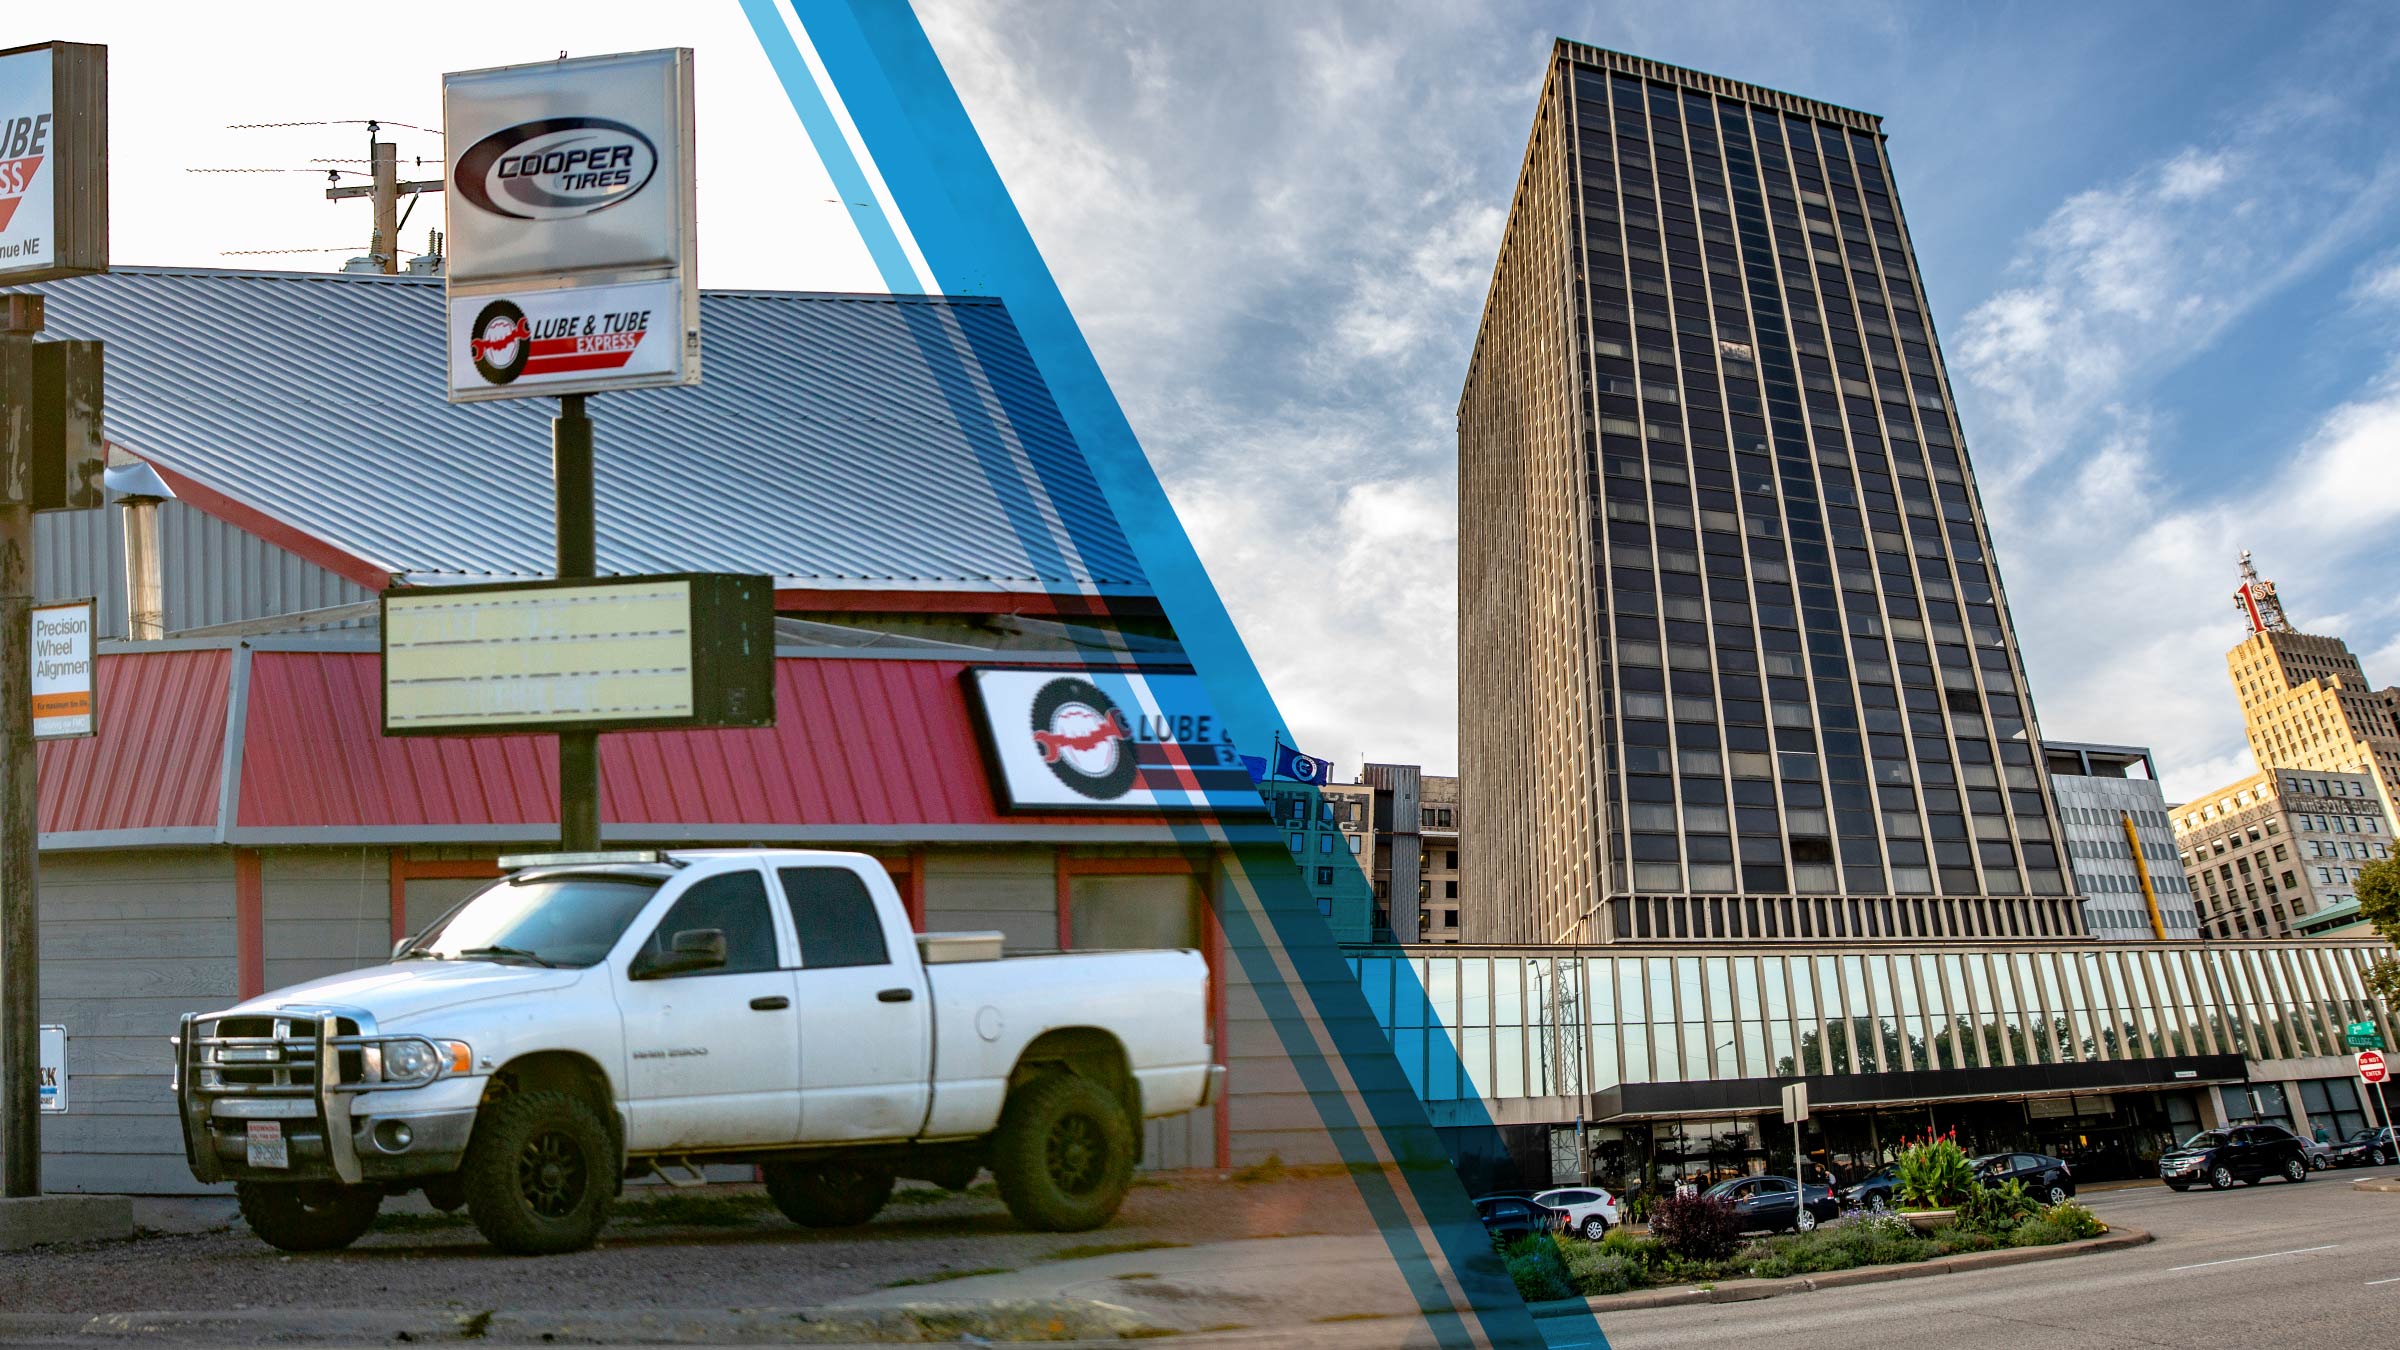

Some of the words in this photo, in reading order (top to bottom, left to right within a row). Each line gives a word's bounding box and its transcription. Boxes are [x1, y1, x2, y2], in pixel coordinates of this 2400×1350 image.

[497, 145, 634, 179] COOPER
[563, 168, 631, 191] TIRES
[23, 238, 40, 256] NE
[533, 317, 580, 340] LUBE
[583, 315, 596, 335] &
[603, 310, 651, 333] TUBE
[576, 333, 636, 353] EXPRESS
[2237, 580, 2276, 634] 1st
[36, 618, 87, 637] Precision
[36, 638, 73, 657] Wheel
[36, 659, 90, 680] Alignmen
[1138, 715, 1212, 743] LUBE
[2286, 798, 2350, 814] MINNESOTA
